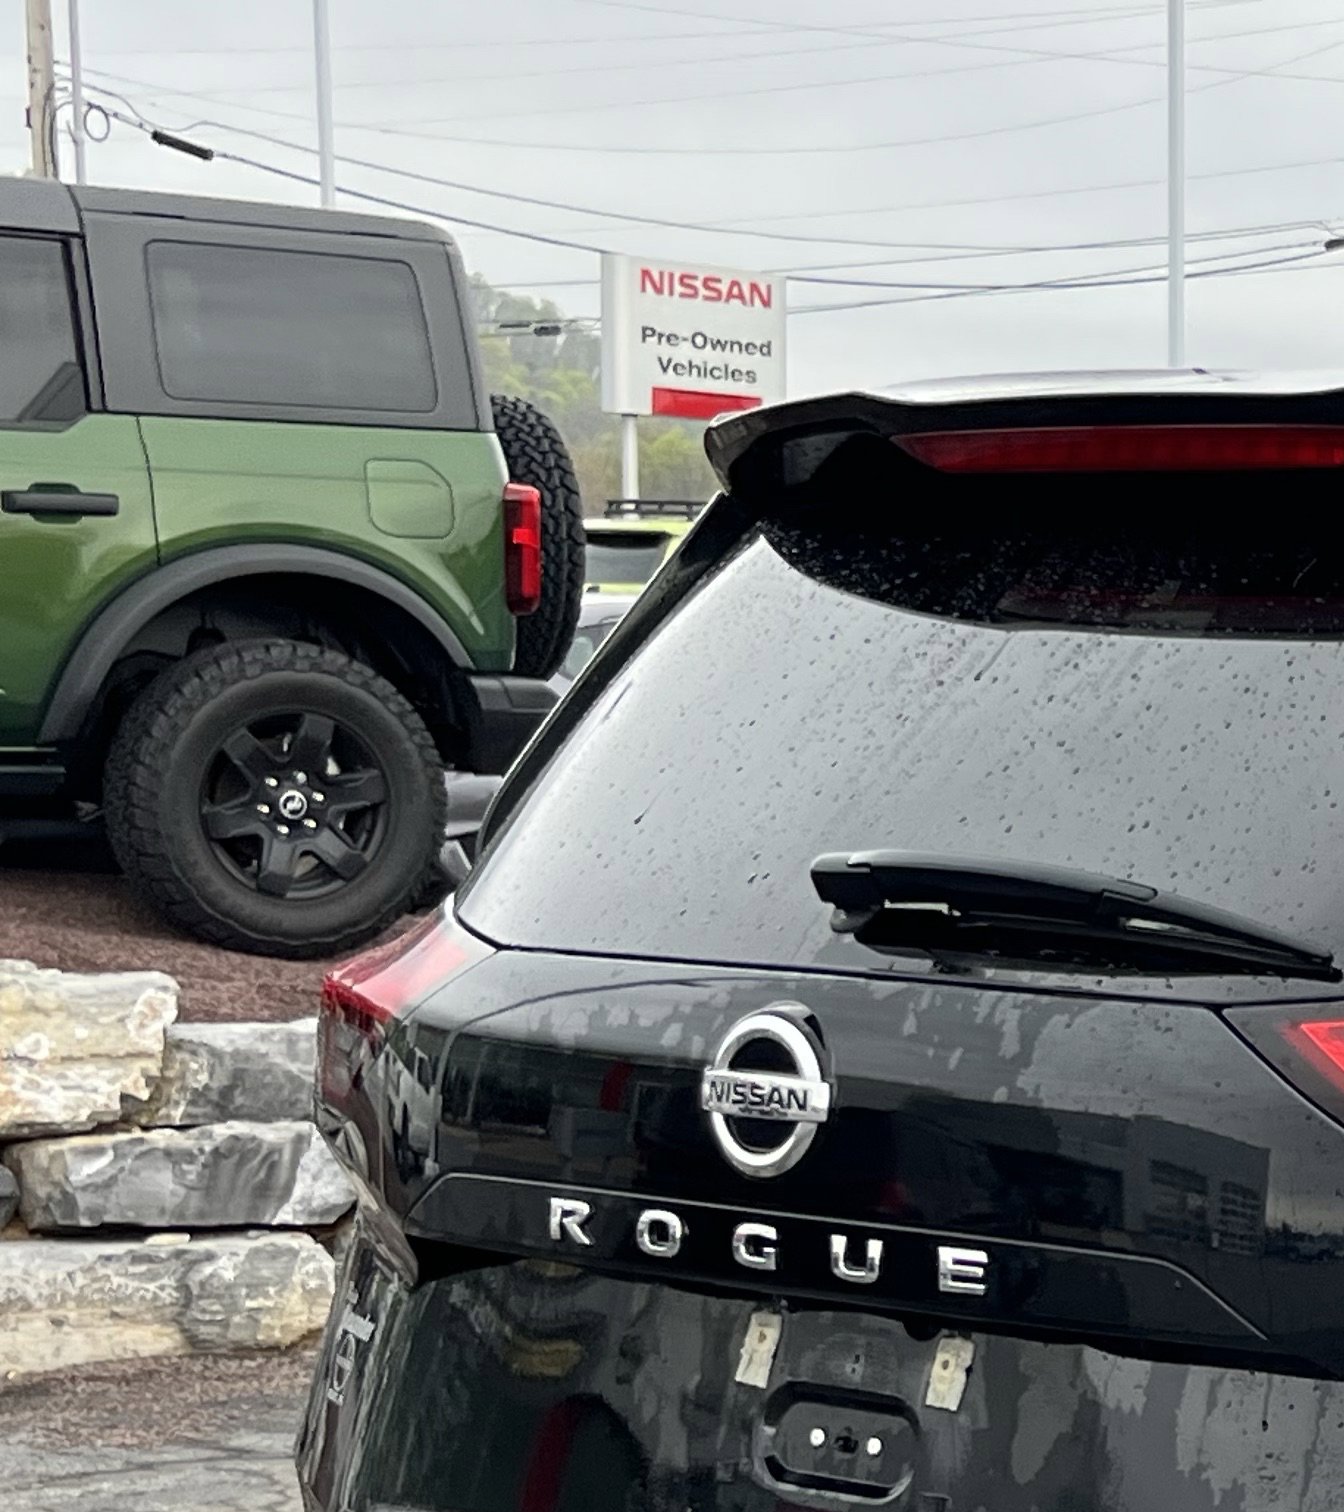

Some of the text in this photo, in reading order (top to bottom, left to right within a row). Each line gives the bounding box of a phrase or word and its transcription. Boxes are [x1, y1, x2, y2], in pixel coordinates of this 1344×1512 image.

[640, 268, 772, 308] NISSAN
[641, 325, 772, 357] Pre-Owned
[657, 356, 757, 384] Vehicles
[709, 1080, 808, 1112] NISSAN
[549, 1196, 990, 1296] ROGUE
